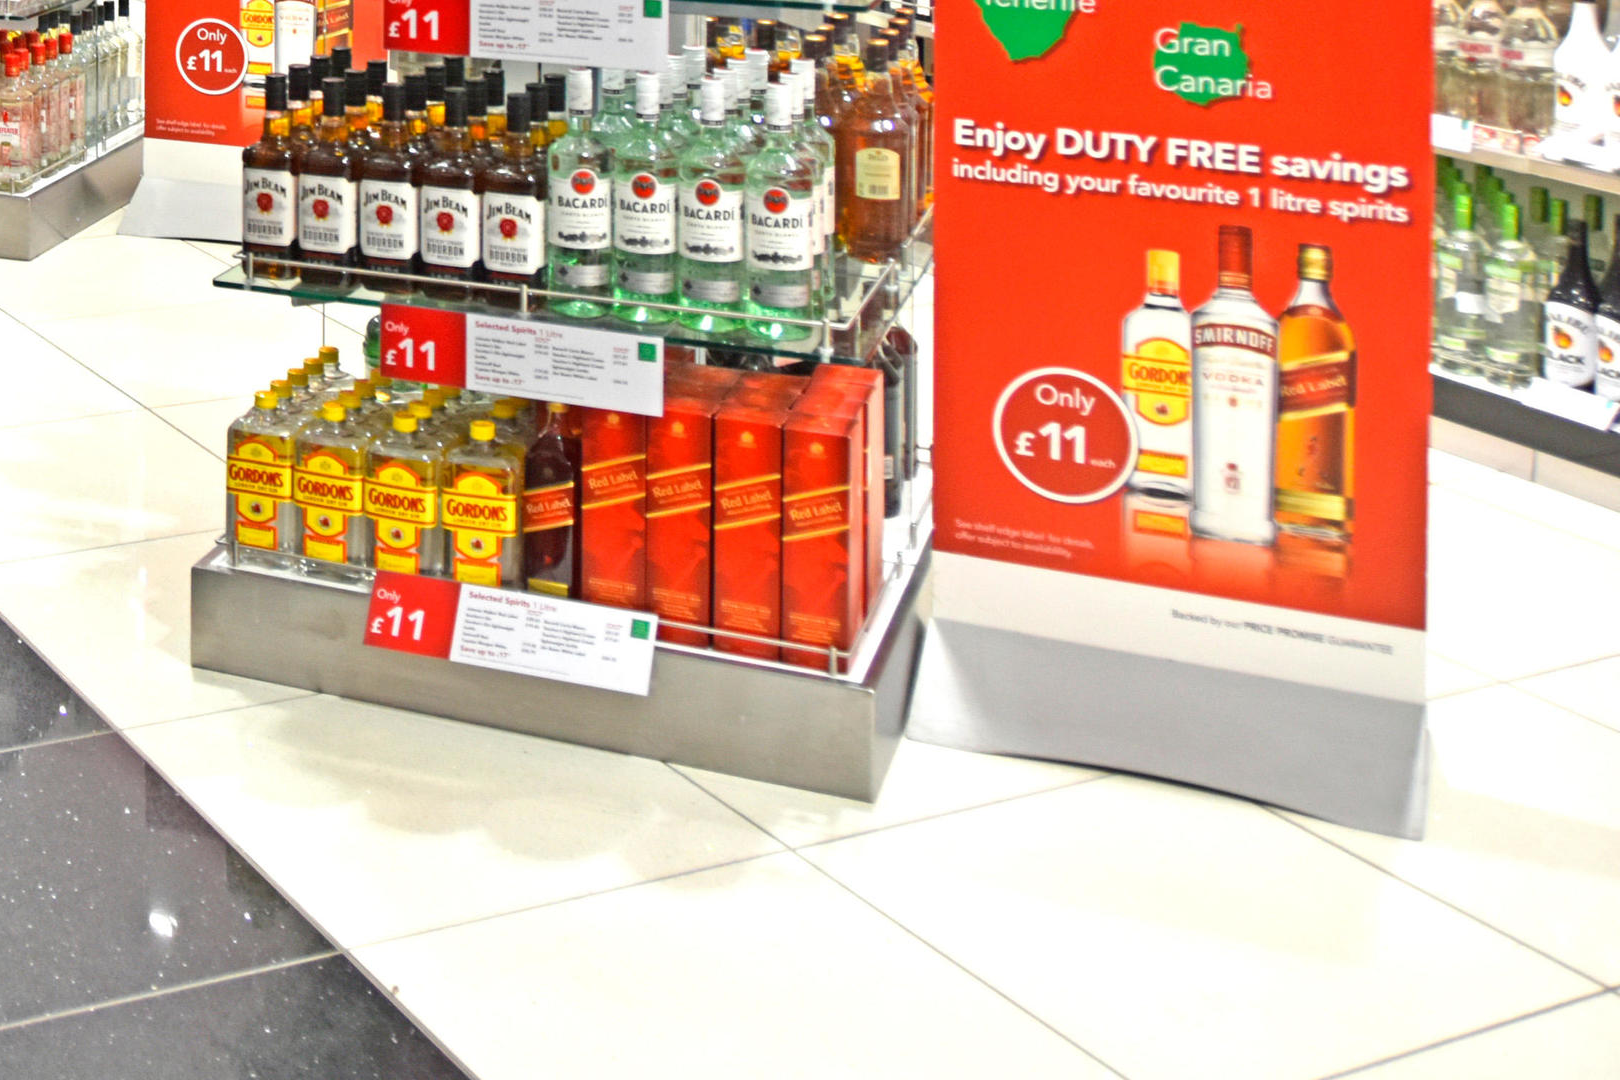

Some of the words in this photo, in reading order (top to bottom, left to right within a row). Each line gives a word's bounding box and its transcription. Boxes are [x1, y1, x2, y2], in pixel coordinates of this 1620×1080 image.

[196, 27, 227, 45] Only
[388, 8, 440, 41] £11
[1154, 27, 1231, 57] Gran
[186, 49, 223, 73] £11
[1154, 65, 1273, 99] Canaria
[953, 119, 1047, 160] Enjoy
[1056, 127, 1156, 163] DUTY
[1167, 138, 1261, 174] FREE
[1271, 153, 1409, 193] savings
[261, 176, 287, 198] BEAM
[317, 183, 343, 205] BEAM
[953, 158, 1060, 193] including
[1066, 172, 1121, 195] your
[1129, 175, 1240, 207] favourite
[1248, 187, 1260, 208] 1
[1270, 188, 1322, 216] litre
[1329, 196, 1410, 223] spirits
[380, 189, 408, 210] BEAM
[441, 195, 468, 218] BEAM
[504, 201, 532, 224] BEAM
[385, 321, 410, 336] Only
[475, 321, 509, 332] Selected
[511, 325, 537, 336] Spirits
[1194, 327, 1274, 352] SMIRNOFF
[385, 338, 435, 371] £11
[1202, 371, 1264, 386] VODKA
[1282, 381, 1305, 396] Red
[1308, 375, 1348, 392] Label
[1034, 383, 1097, 417] Only
[1014, 421, 1087, 464] £11
[1090, 457, 1116, 470] each
[230, 463, 283, 488] GORDON'S
[588, 477, 610, 490] Red
[612, 470, 638, 486] Label
[297, 478, 353, 502] GORDON'S
[368, 487, 426, 513] GORDON'S
[652, 486, 674, 498] Red
[676, 479, 702, 494] Label
[721, 497, 743, 510] Red
[745, 490, 772, 506] Label
[447, 498, 507, 522] GORDON'S
[526, 503, 541, 515] Red
[542, 497, 570, 511] Label
[790, 509, 812, 522] Red
[814, 502, 843, 518] Label
[377, 588, 401, 604] Only
[469, 591, 503, 604] Selected
[504, 596, 530, 608] Spirits
[370, 605, 426, 641] £11
[1172, 608, 1208, 624] Backed
[1209, 617, 1221, 628] by
[1243, 621, 1273, 635] PRICE
[1276, 626, 1324, 643] PROMISE
[1327, 635, 1393, 655] GUARANTEE
